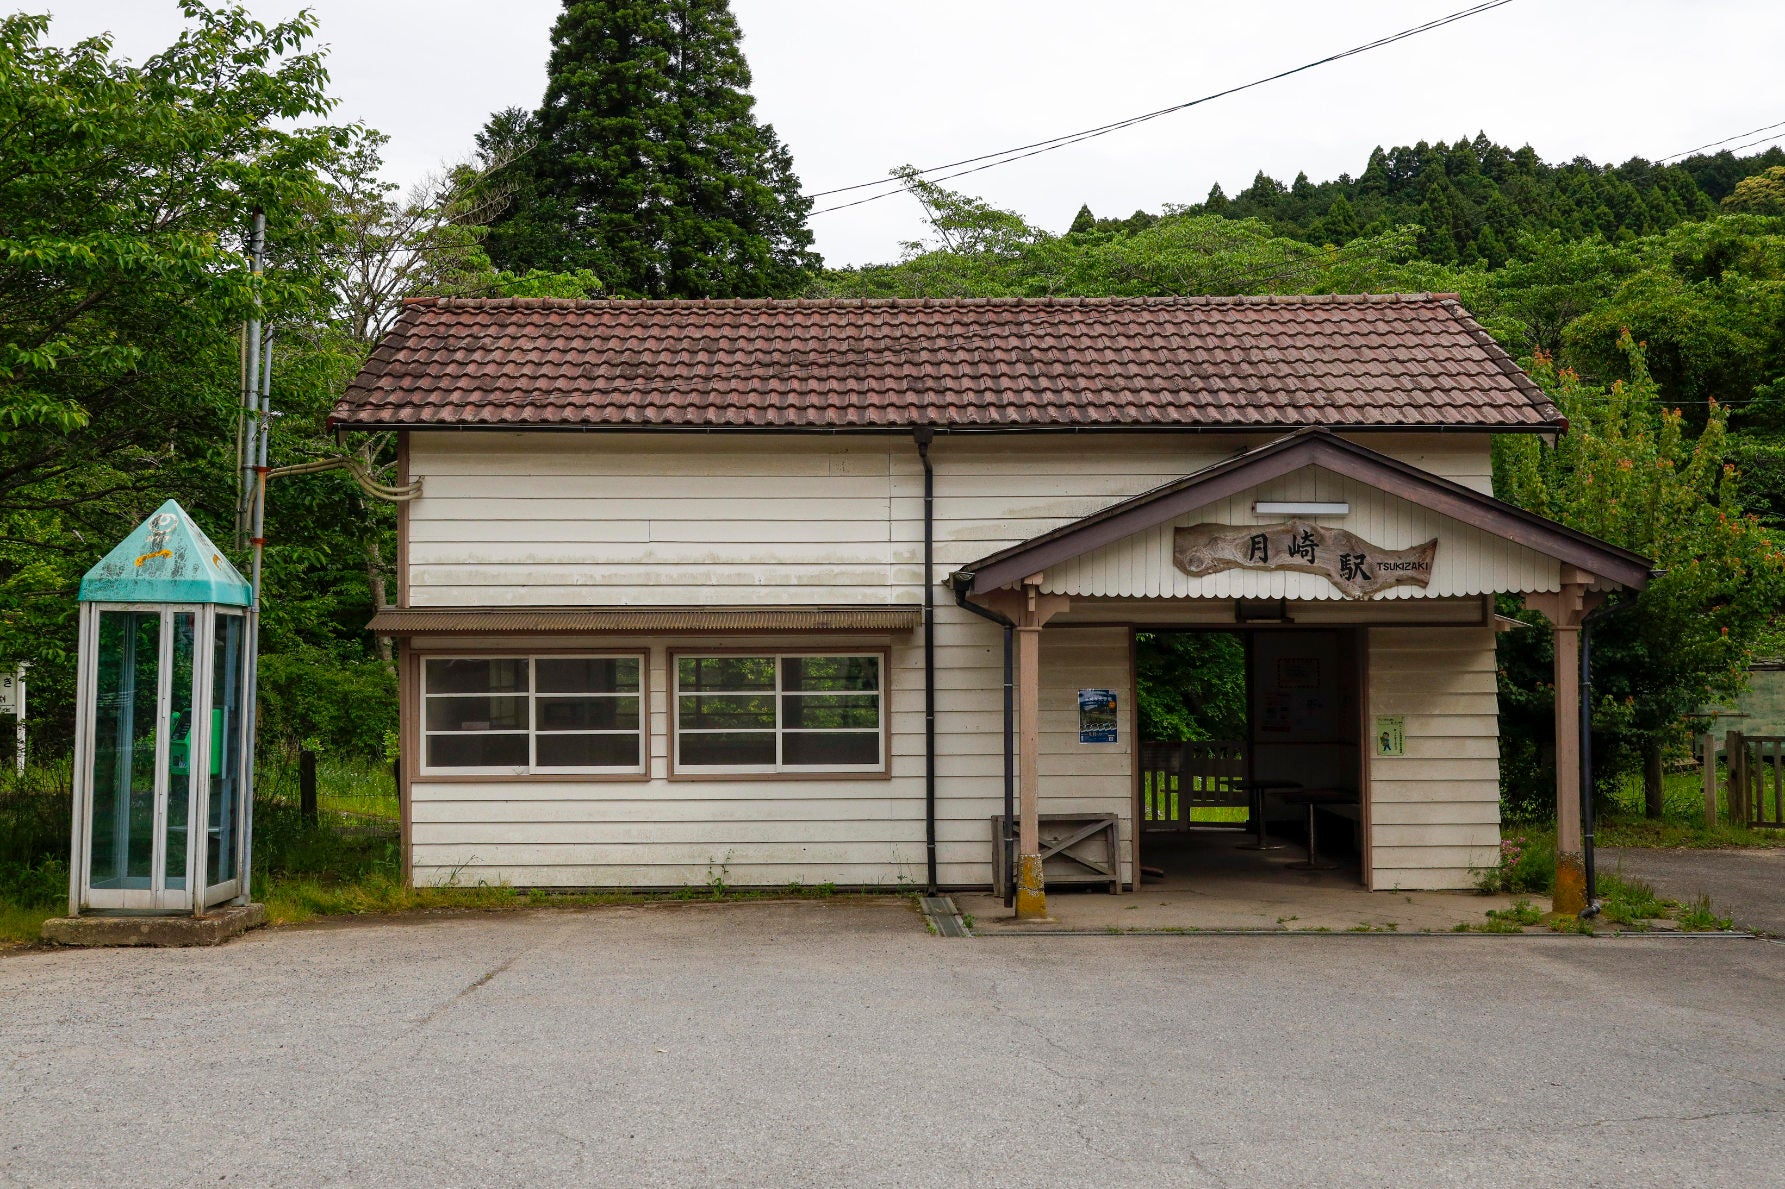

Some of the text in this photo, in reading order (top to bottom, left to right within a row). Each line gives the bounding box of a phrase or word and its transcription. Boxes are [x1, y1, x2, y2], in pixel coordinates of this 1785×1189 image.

[1249, 529, 1428, 581] 月崎駅 TSUKIZAKI
